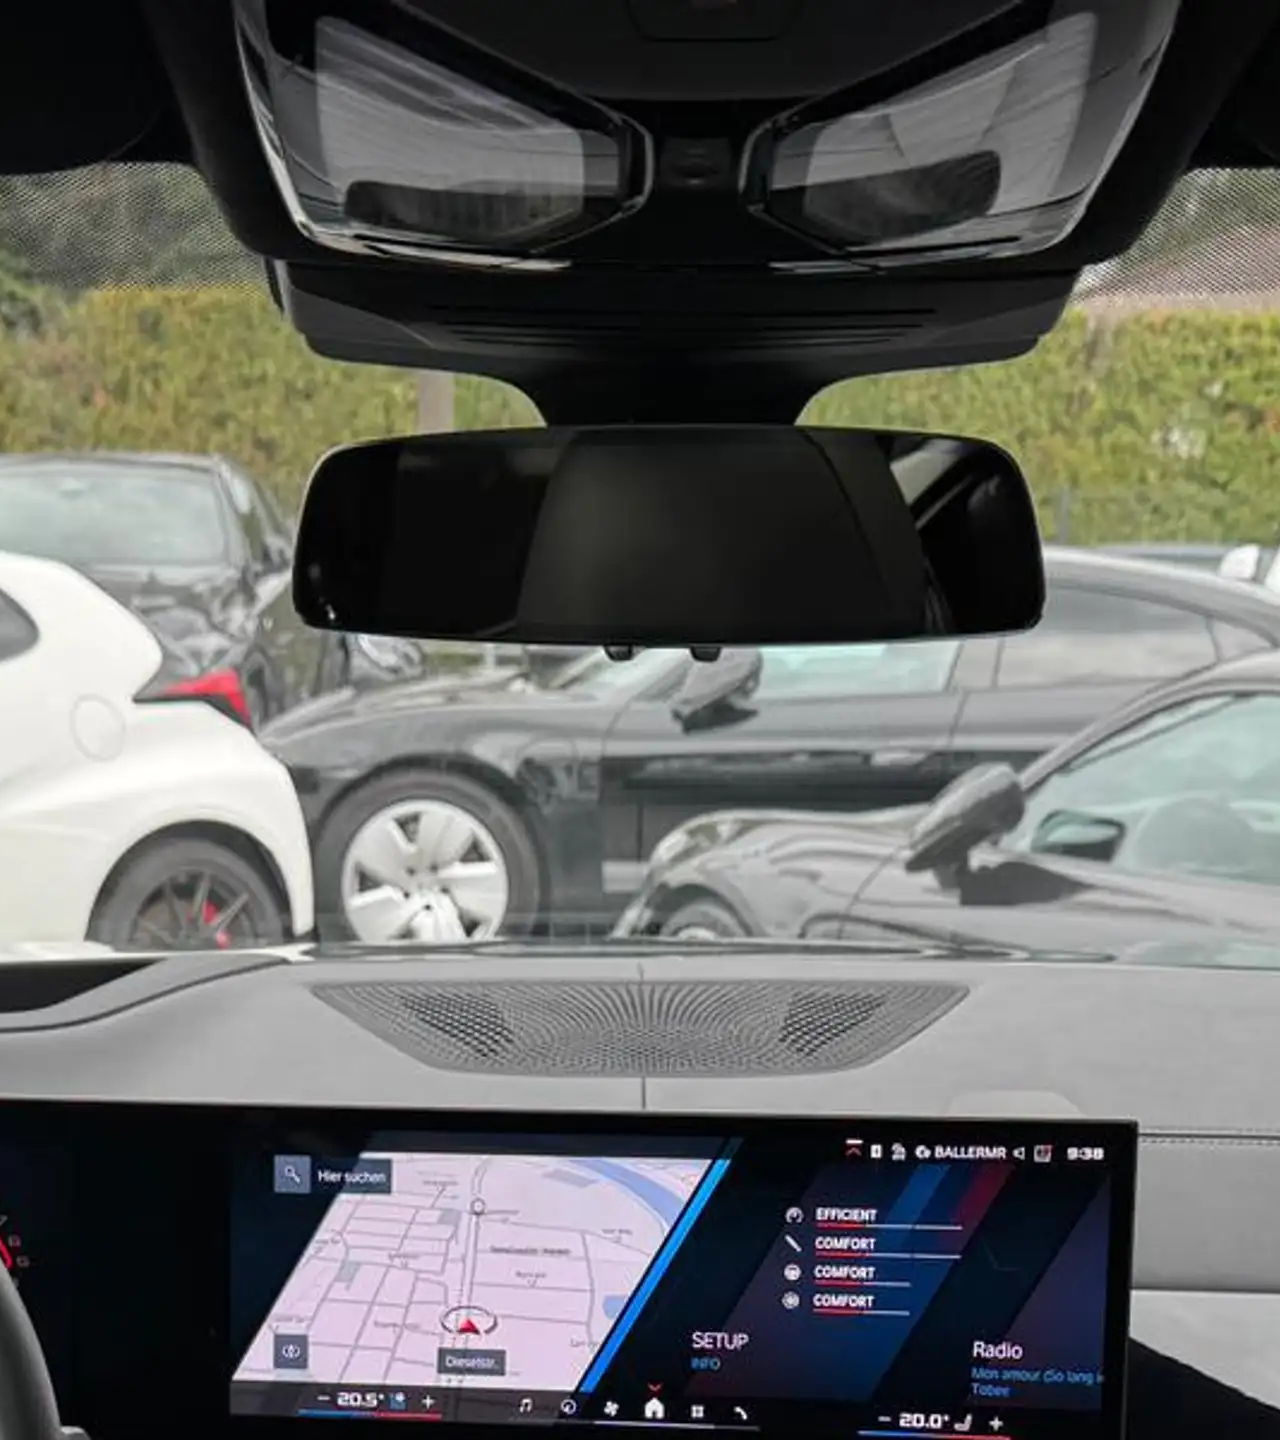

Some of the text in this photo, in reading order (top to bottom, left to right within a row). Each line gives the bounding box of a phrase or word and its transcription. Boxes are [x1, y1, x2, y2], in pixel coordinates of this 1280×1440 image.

[934, 1144, 1007, 1160] BALLERMR
[1067, 1146, 1105, 1161] 9:38
[317, 1168, 387, 1185] Hier suchen
[815, 1207, 877, 1222] EFFICIENT
[814, 1236, 877, 1251] COMFORT
[813, 1265, 876, 1280] COMFORT
[812, 1293, 875, 1308] COMFORT
[691, 1331, 750, 1351] SETUP
[972, 1340, 1024, 1360] Radio
